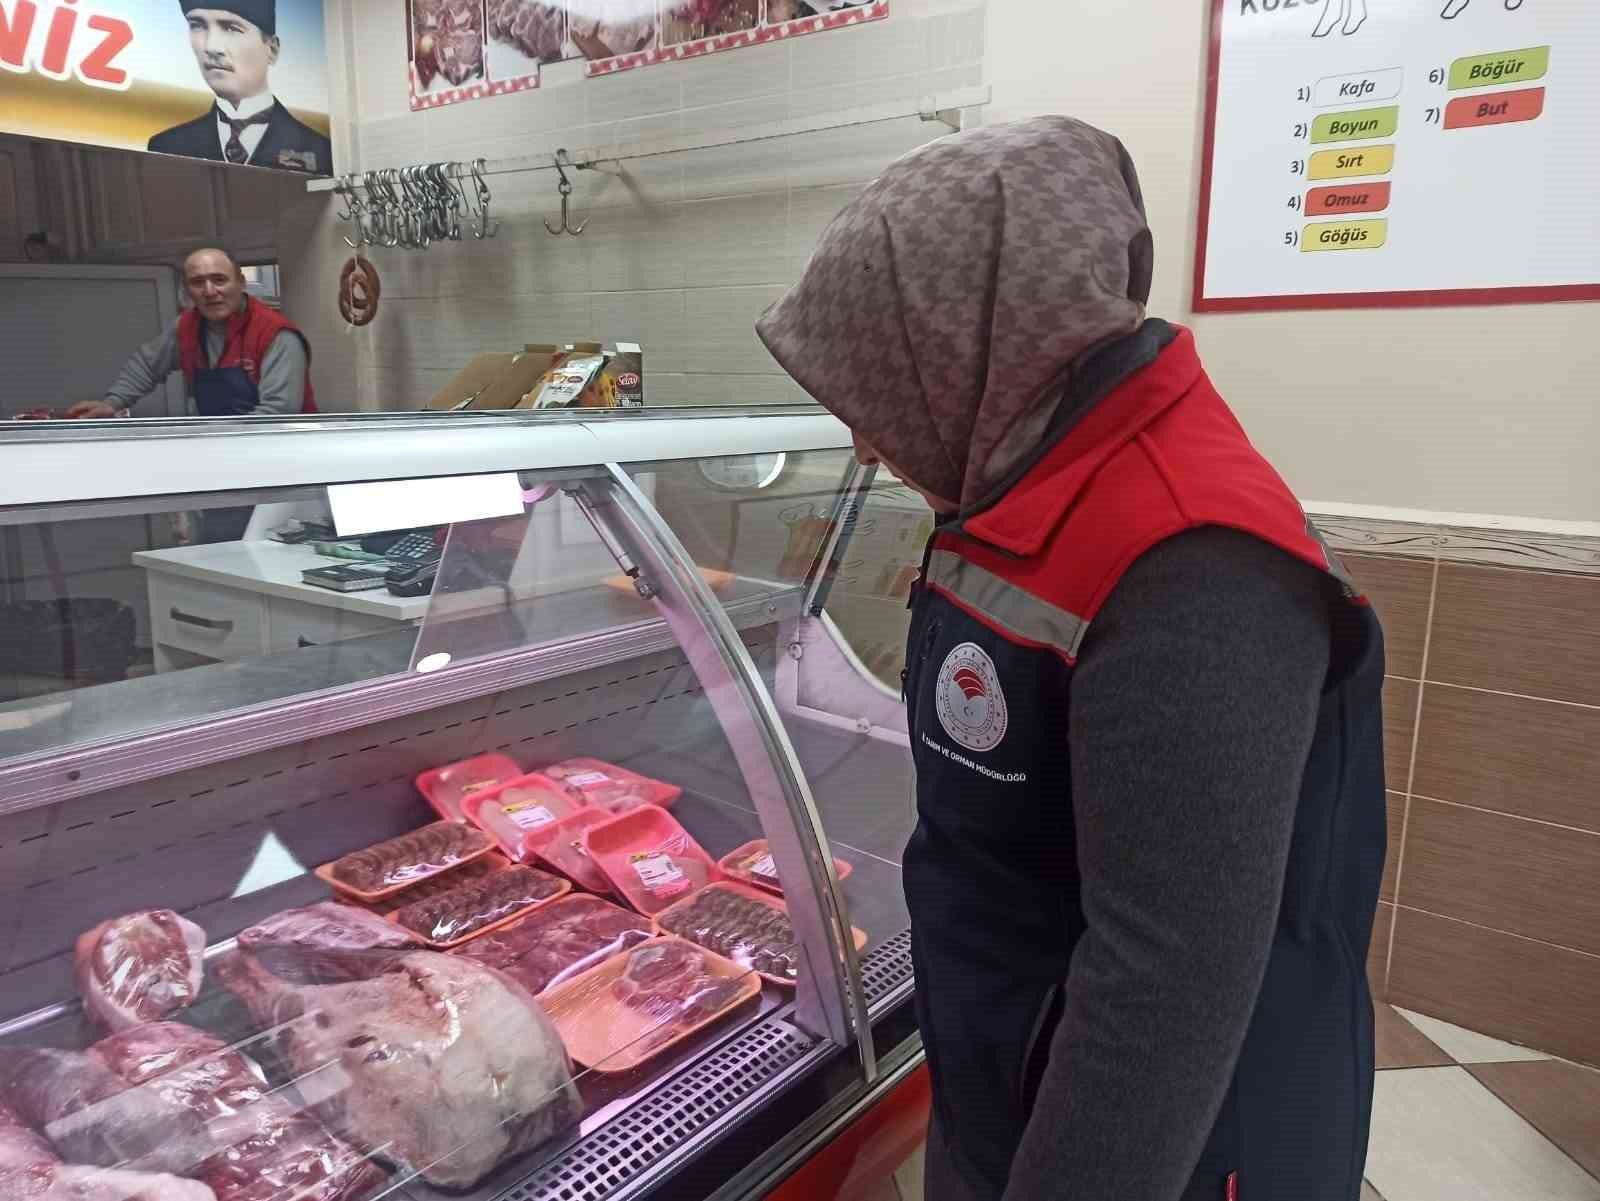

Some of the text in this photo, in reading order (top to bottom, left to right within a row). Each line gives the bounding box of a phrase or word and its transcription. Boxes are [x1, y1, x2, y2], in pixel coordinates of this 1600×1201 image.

[1429, 59, 1524, 85] 6) Böğür
[1297, 79, 1375, 102] 1) Kafa
[1425, 101, 1509, 125] 7) But
[1294, 117, 1379, 139] 2) Boyun
[1290, 154, 1364, 175] 3) Sırt
[1287, 192, 1370, 211] 4) Omuz
[1284, 228, 1368, 247] 5) Göğüs
[950, 752, 975, 769] ORMAN
